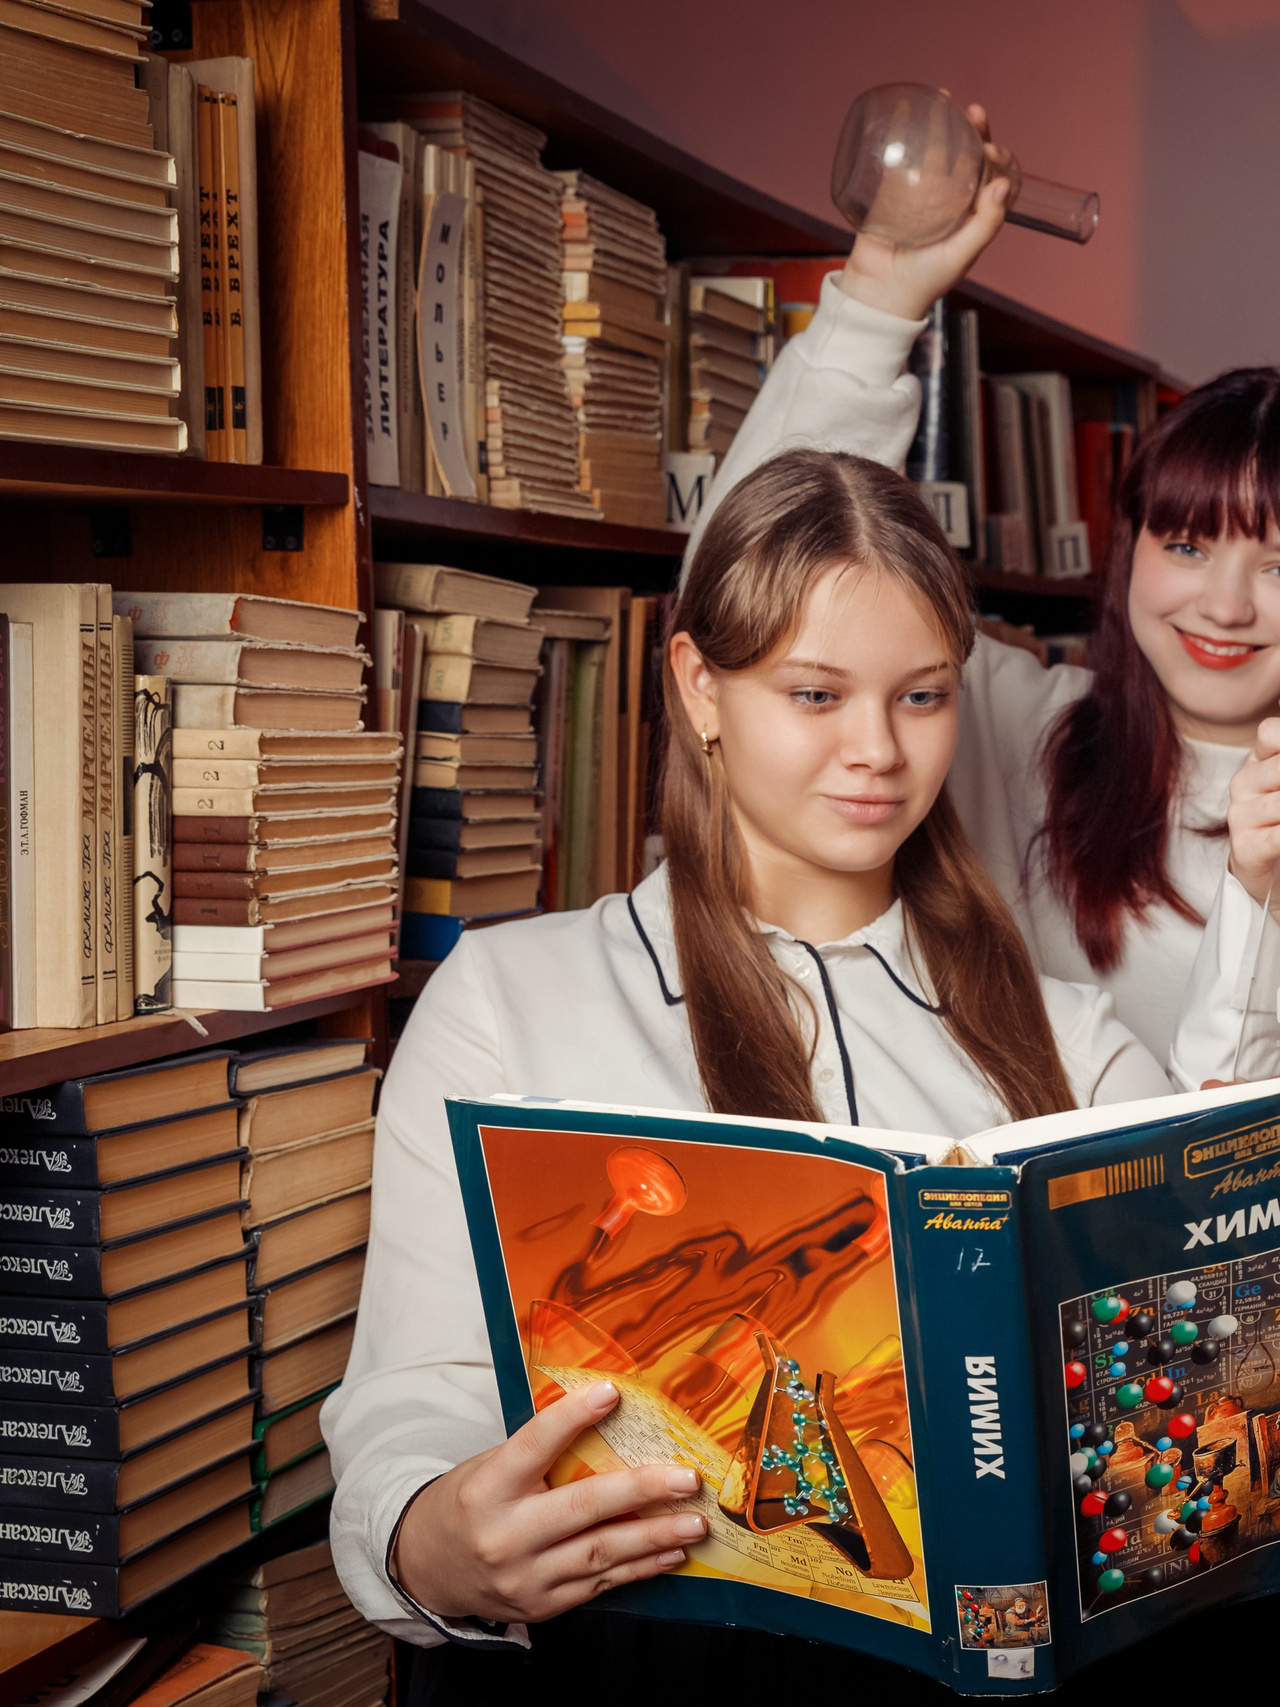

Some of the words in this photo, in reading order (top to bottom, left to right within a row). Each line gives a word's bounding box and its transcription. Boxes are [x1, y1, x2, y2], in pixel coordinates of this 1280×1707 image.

[199, 186, 212, 293] БРЕХТ
[226, 189, 241, 293] БРЕХТ
[377, 219, 391, 437] ЛИТЕРАТУРА
[667, 473, 706, 525] М
[82, 637, 97, 825] МАРСЕЛЬЦЫ
[99, 639, 113, 823] МАРСЕЛЬЦЫ
[923, 1192, 1008, 1202] ЭНЦИКЛОПЕДИЯ
[1208, 1290, 1217, 1298] 31
[1235, 1283, 1262, 1298] Ge
[1234, 1301, 1267, 1312] ГЕРМАНИЙ
[1139, 1339, 1148, 1349] 38
[1094, 1354, 1116, 1370] Sr
[1167, 1366, 1187, 1379] In
[1108, 1387, 1116, 1396] 48
[964, 1355, 1006, 1480] ХИМИЯ
[753, 1542, 769, 1554] Fm
[790, 1555, 807, 1567] Md
[835, 1566, 853, 1577] No
